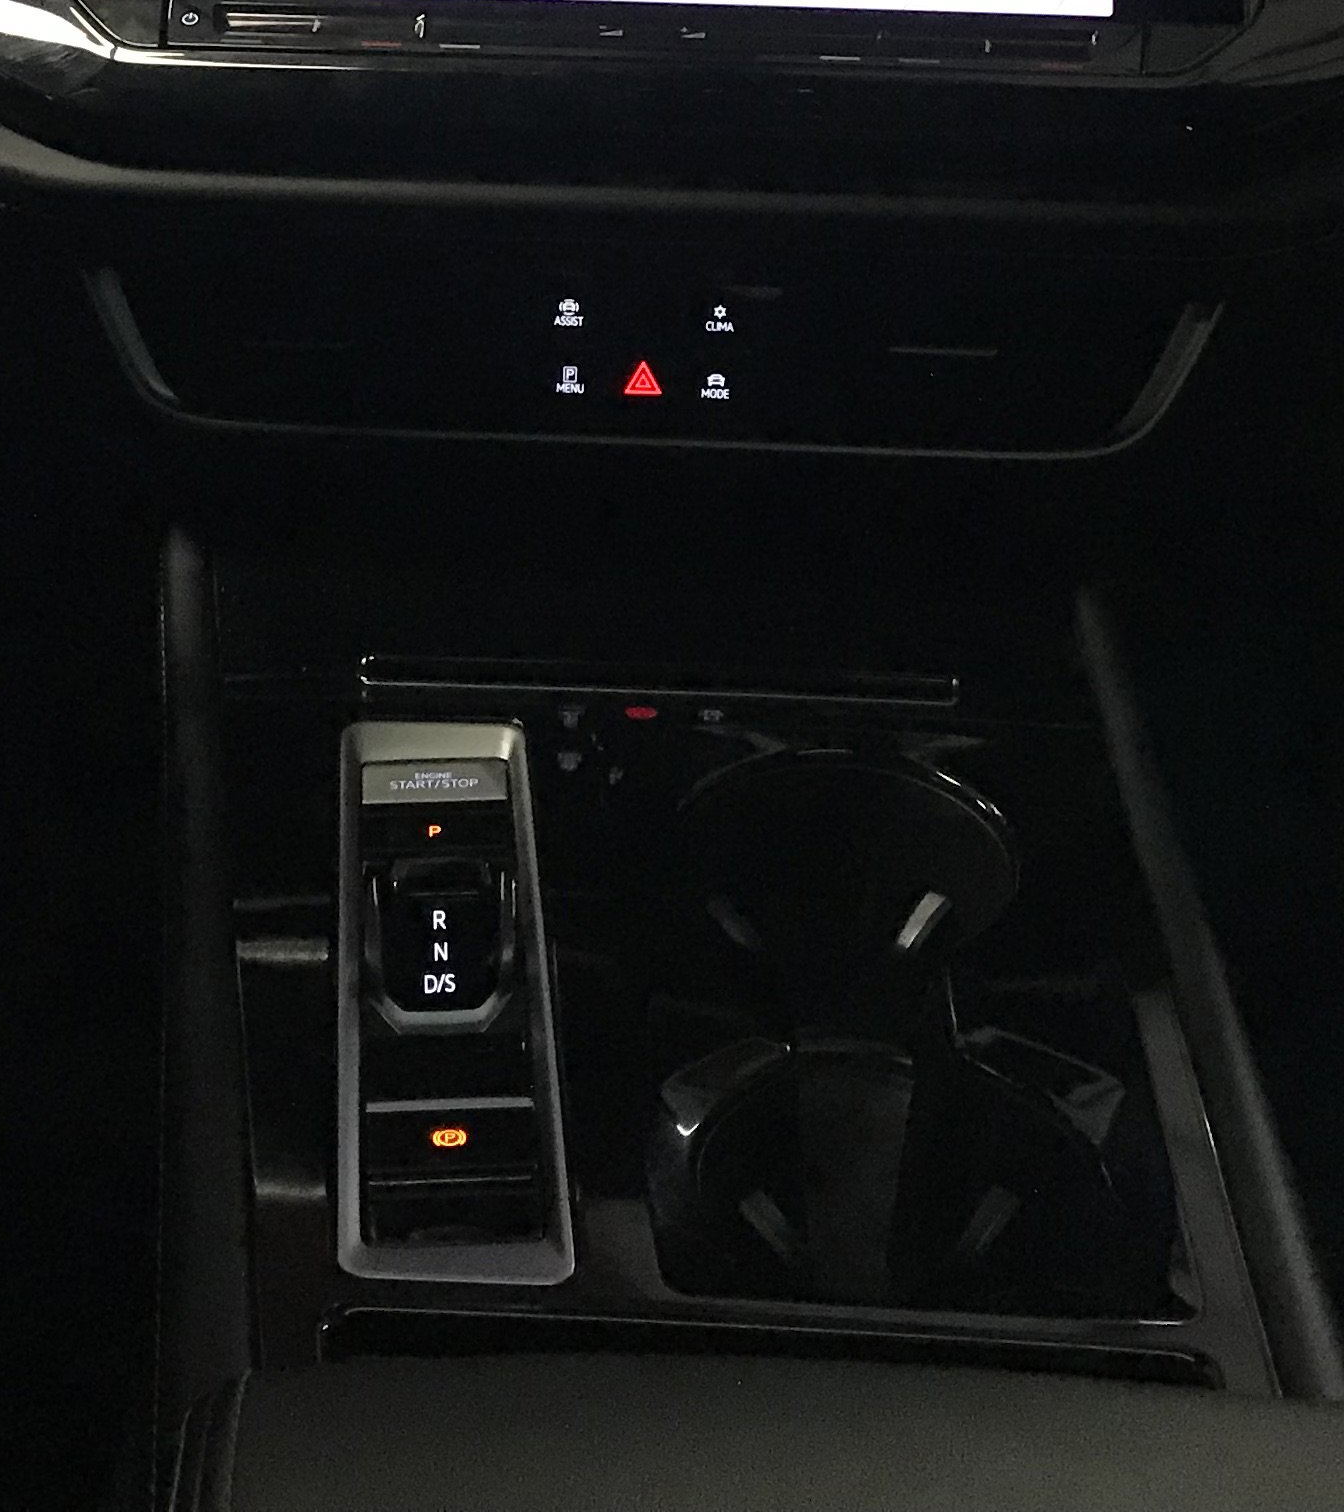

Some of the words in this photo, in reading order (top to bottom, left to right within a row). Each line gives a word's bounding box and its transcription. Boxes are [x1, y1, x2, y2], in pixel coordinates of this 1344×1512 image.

[554, 315, 584, 326] ASSIST
[705, 320, 734, 332] CLIMA
[556, 382, 585, 394] MENU
[700, 388, 730, 400] MODE
[414, 771, 453, 780] ENGINE
[389, 778, 479, 790] START/STOP
[428, 825, 442, 838] P
[432, 909, 447, 930] R
[433, 941, 449, 962] N
[423, 973, 456, 994] D/S
